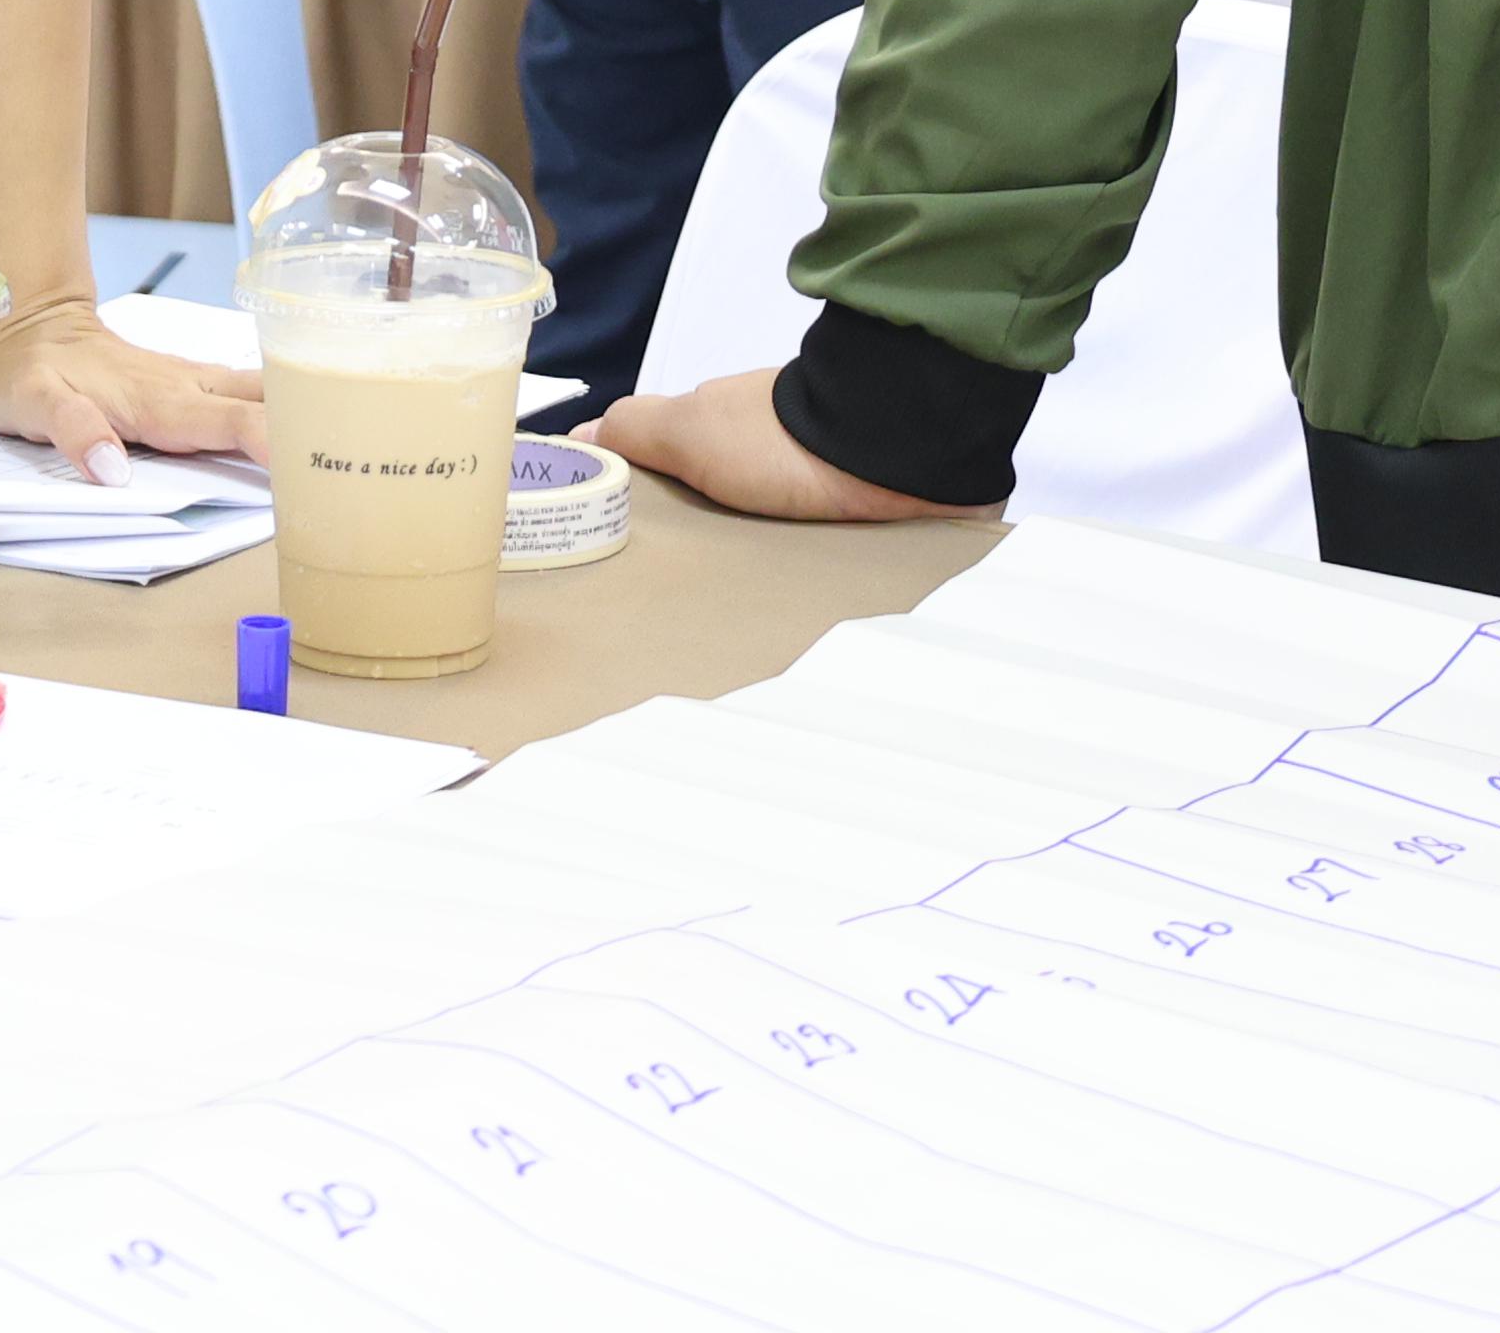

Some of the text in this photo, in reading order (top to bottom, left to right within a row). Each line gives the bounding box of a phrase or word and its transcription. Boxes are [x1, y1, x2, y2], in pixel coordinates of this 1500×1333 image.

[310, 451, 352, 472] Have
[360, 461, 371, 474] a
[380, 460, 417, 476] nice
[1393, 833, 1467, 867] 28
[1286, 856, 1380, 903] 27
[1152, 918, 1234, 958] 26
[903, 971, 1006, 1026] 24
[770, 1019, 859, 1071] 23
[625, 1059, 723, 1117] 22
[469, 1121, 547, 1179] 21
[282, 1179, 380, 1241] 20
